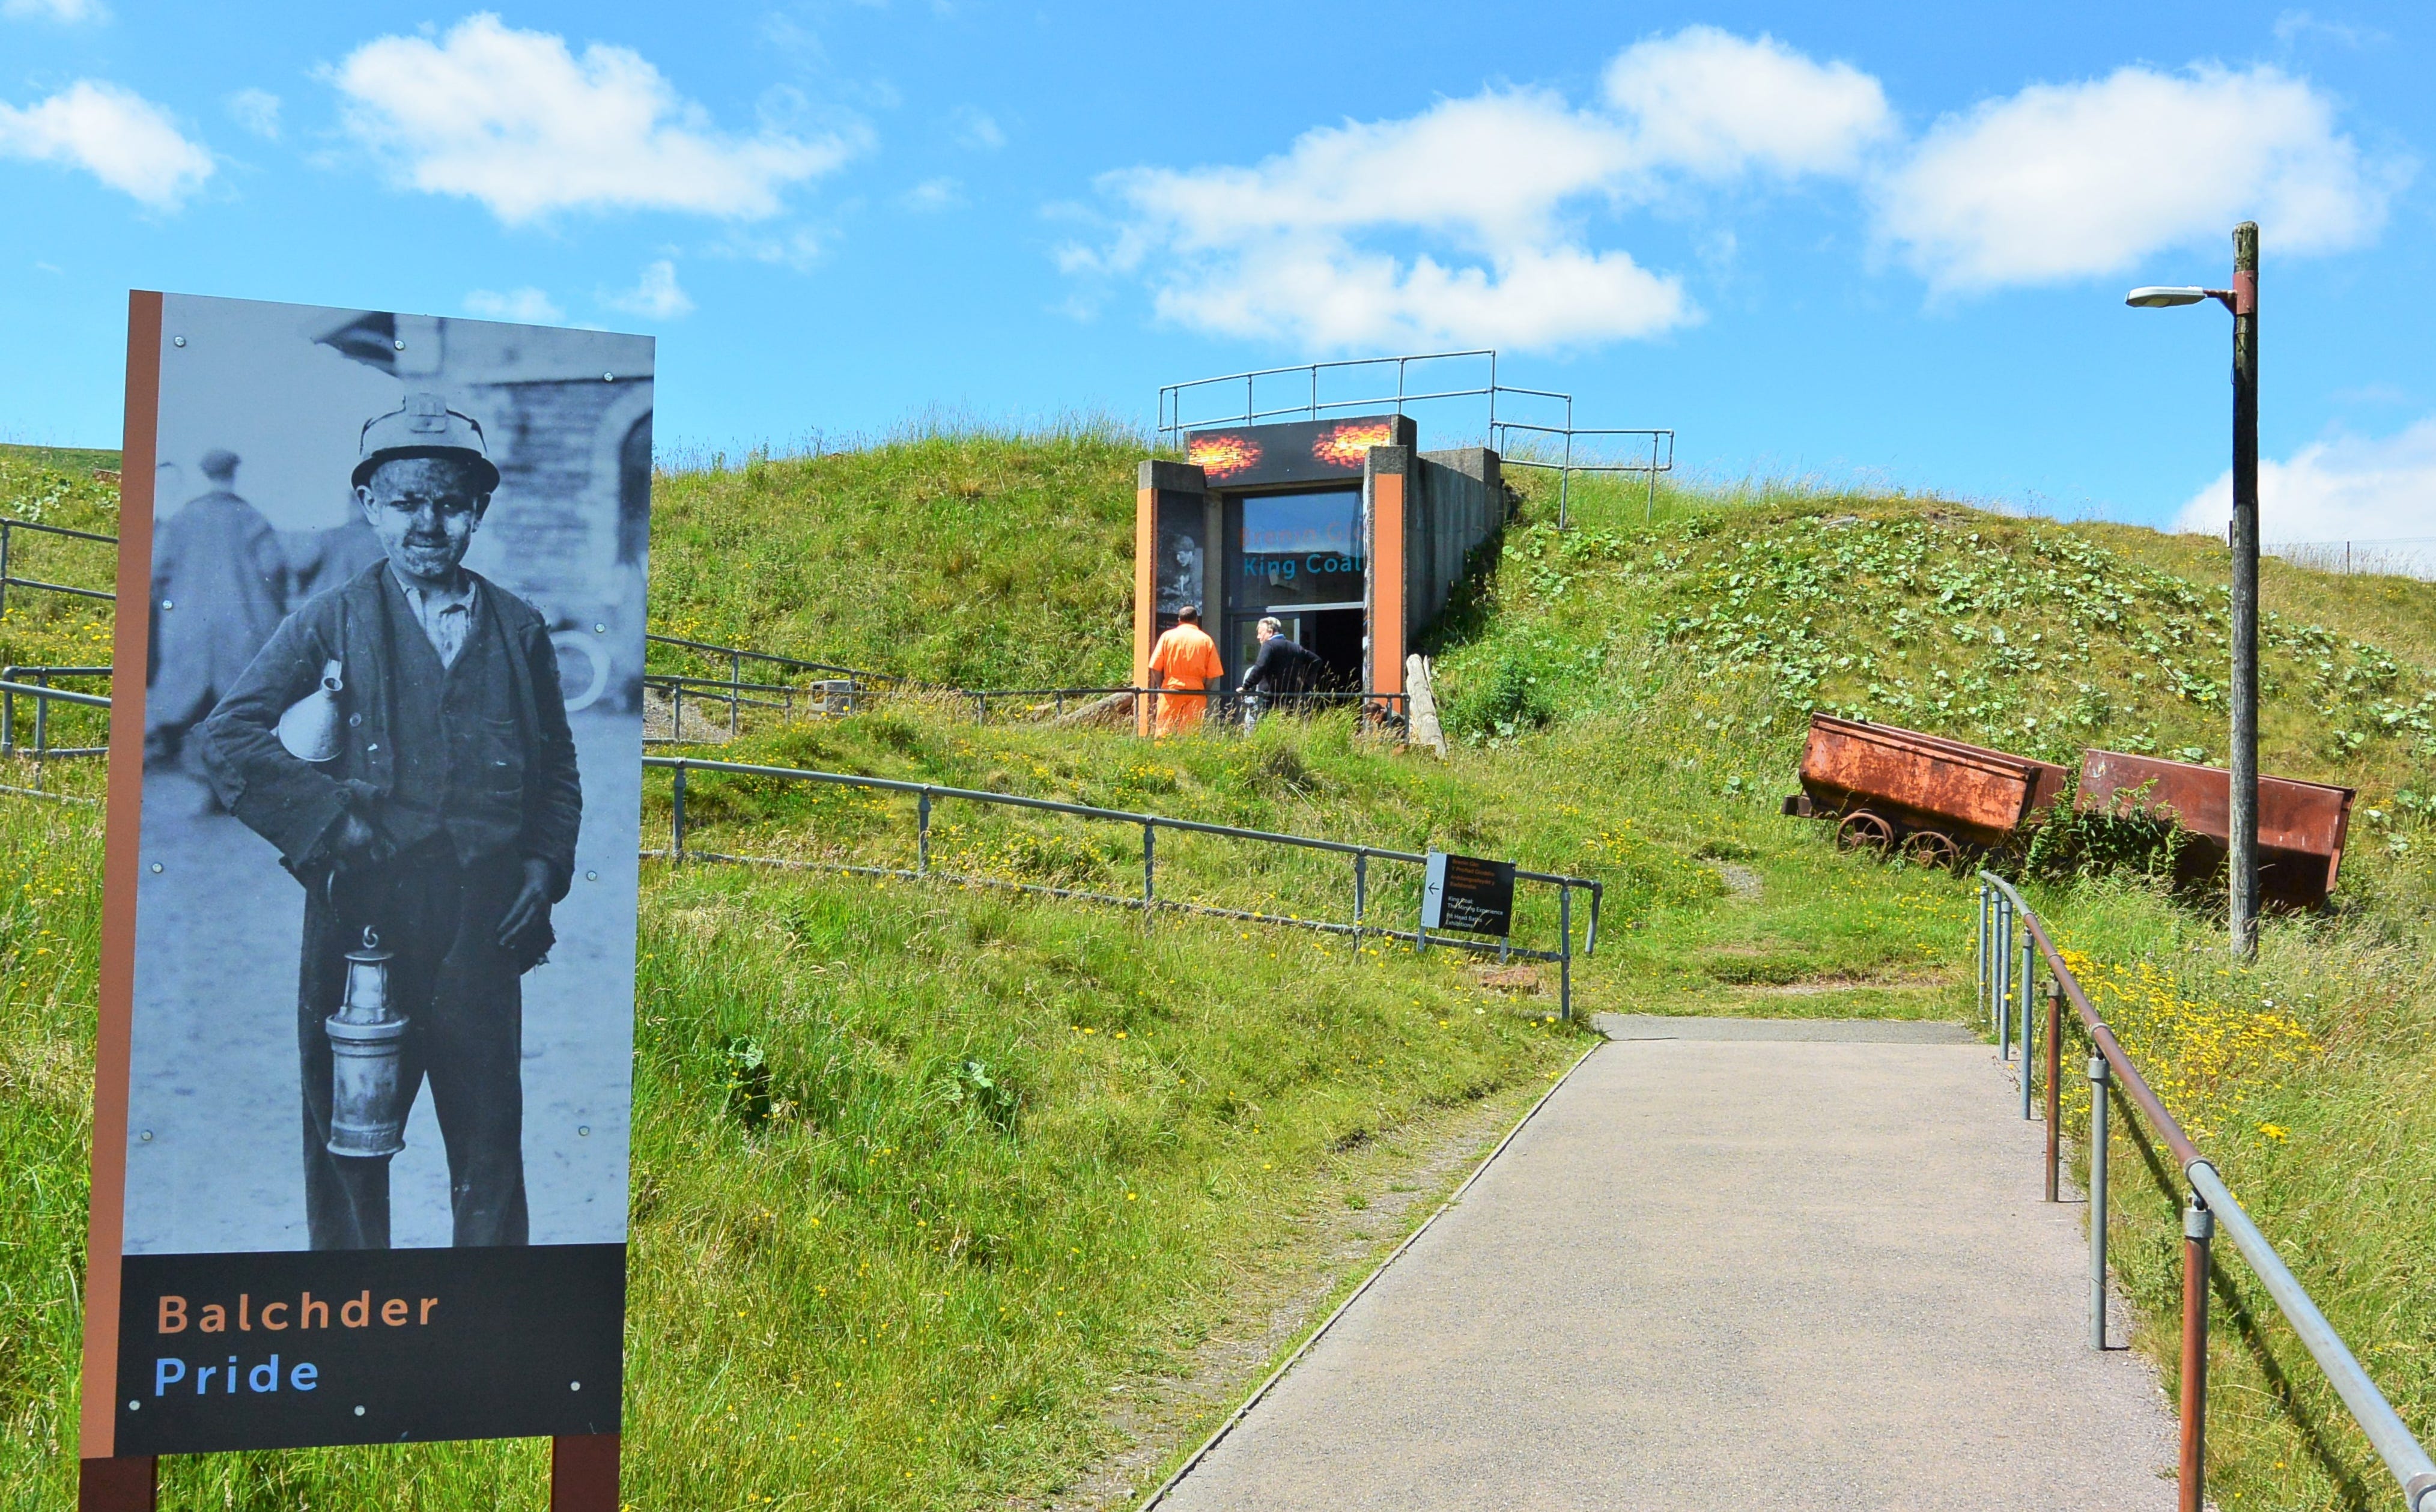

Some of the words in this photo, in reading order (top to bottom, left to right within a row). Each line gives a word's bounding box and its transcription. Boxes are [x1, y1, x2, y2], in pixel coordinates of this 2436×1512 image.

[1244, 556, 1297, 580] King
[1306, 553, 1361, 574] Coal
[158, 1290, 439, 1334] Balchder
[154, 1353, 319, 1397] Pride
